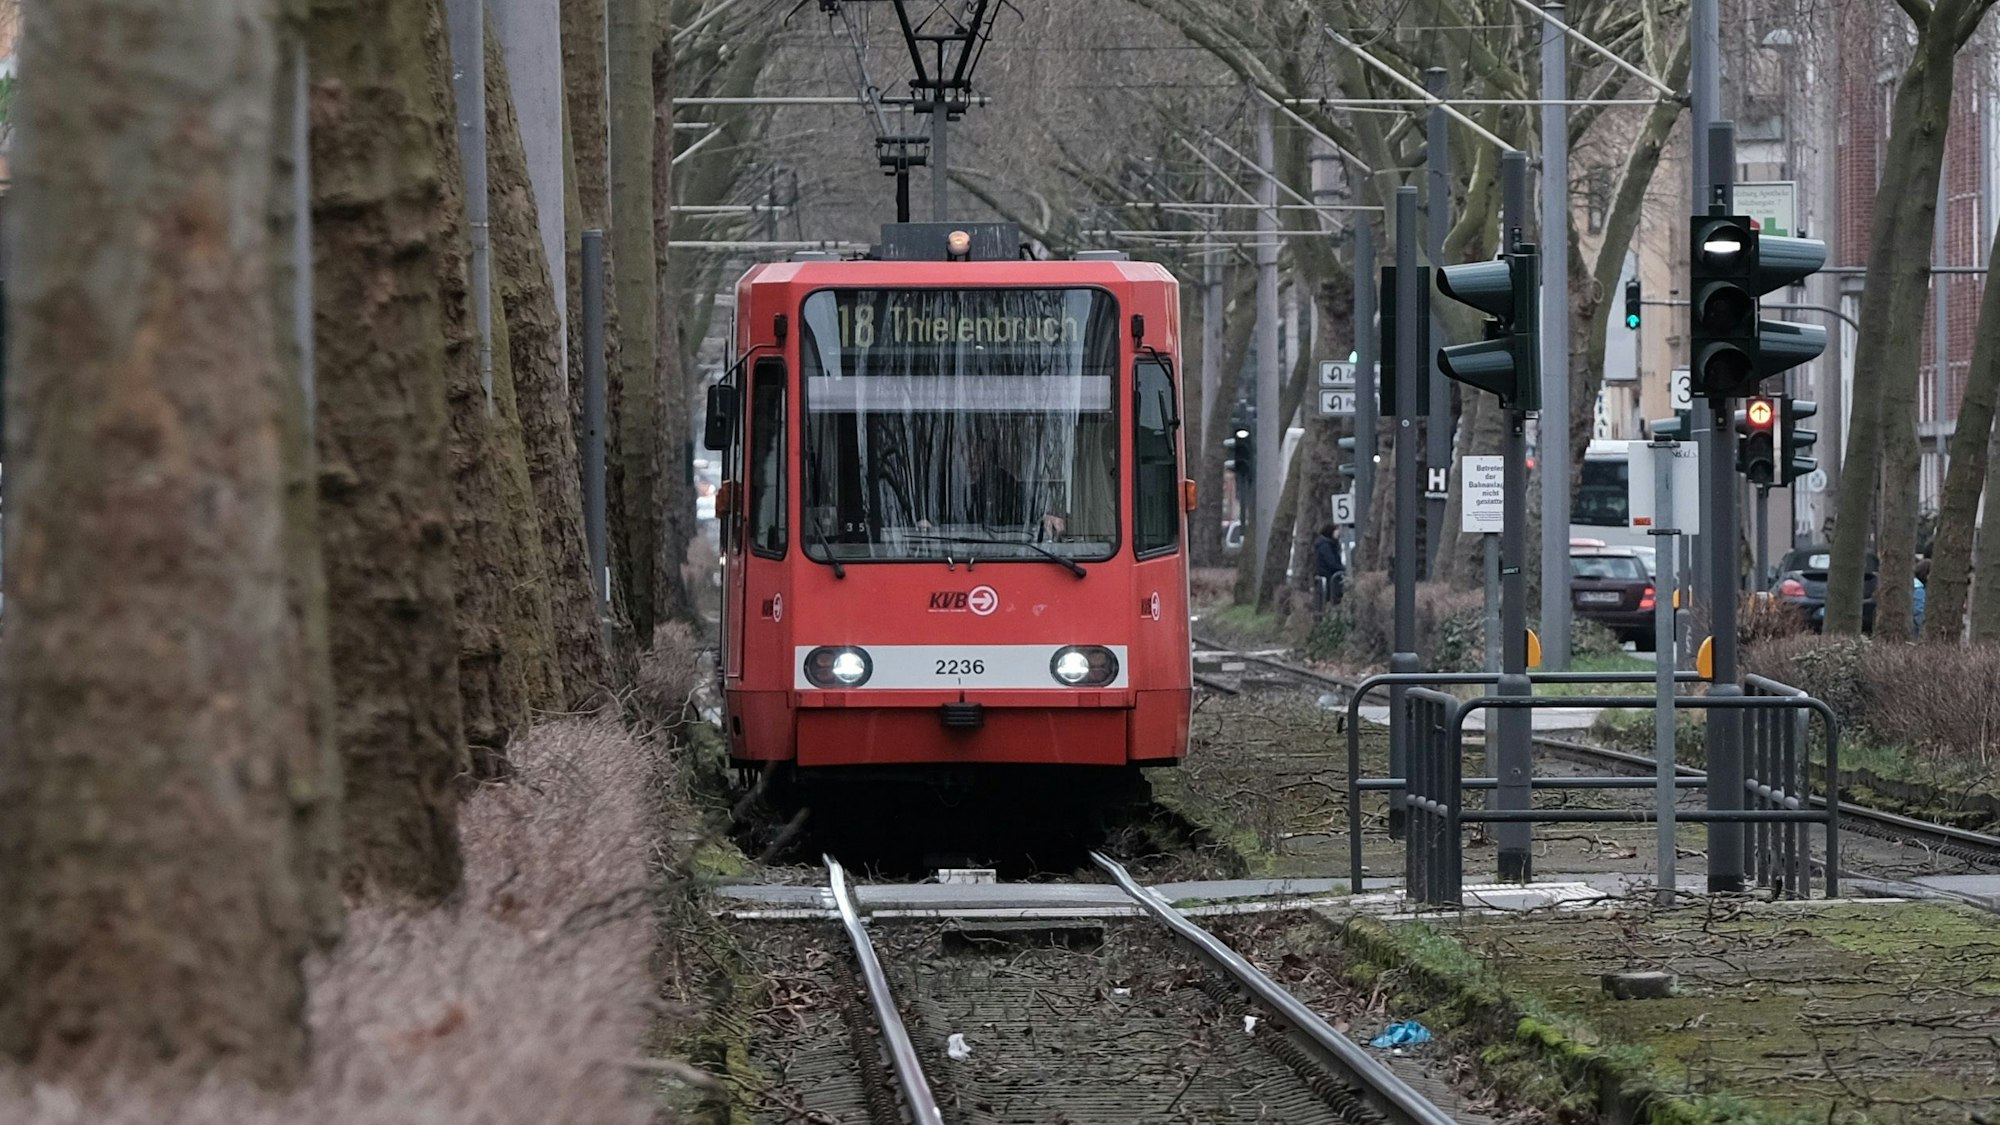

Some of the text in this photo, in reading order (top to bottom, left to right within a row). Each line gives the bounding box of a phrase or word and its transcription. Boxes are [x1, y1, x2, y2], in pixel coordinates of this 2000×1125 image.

[839, 303, 1078, 348] 18 Thielenbruch
[1677, 375, 1691, 404] 3
[1428, 467, 1446, 491] H
[1481, 489, 1500, 497] nicht
[1338, 497, 1350, 520] 5
[929, 591, 968, 609] KVB
[935, 659, 985, 675] 2236
